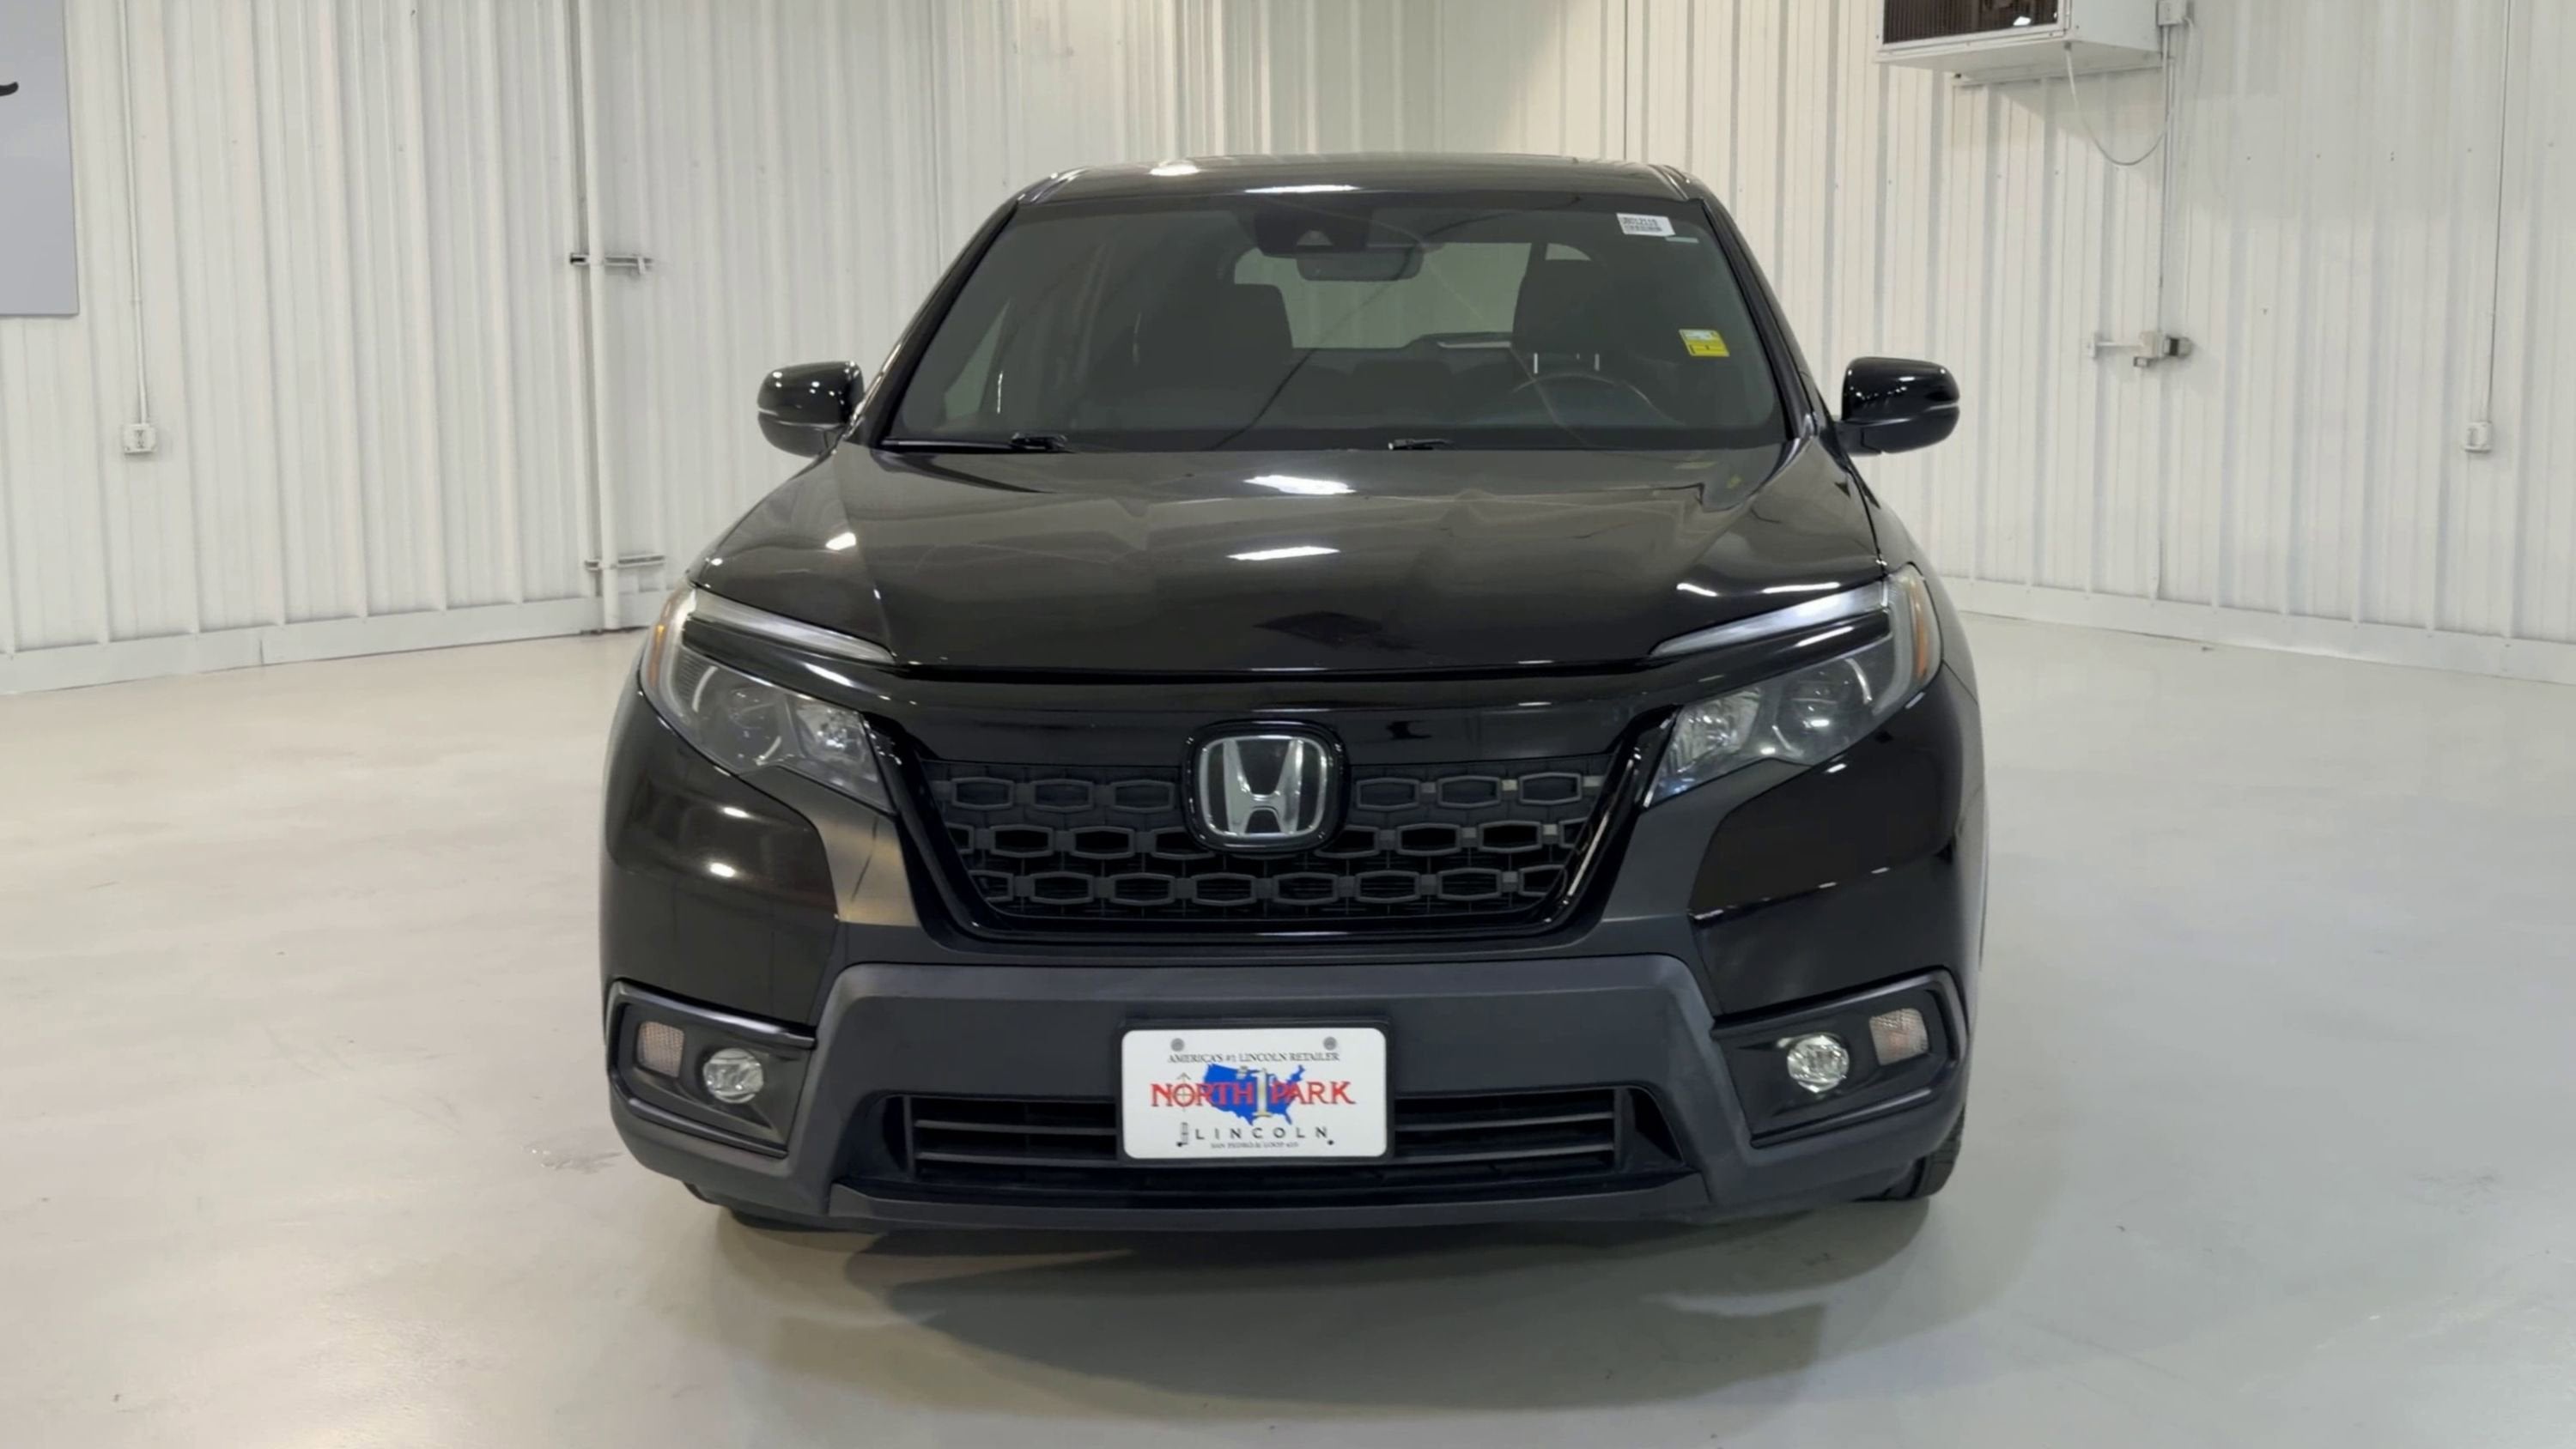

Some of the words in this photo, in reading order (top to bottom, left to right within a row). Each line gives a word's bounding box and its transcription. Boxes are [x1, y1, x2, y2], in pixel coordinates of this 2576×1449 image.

[1239, 1052, 1287, 1063] LINCOLN
[1289, 1052, 1340, 1062] RETAILER
[1151, 1081, 1255, 1107] NORTH
[1271, 1080, 1356, 1106] PARK
[1194, 1126, 1328, 1141] LINCOLN
